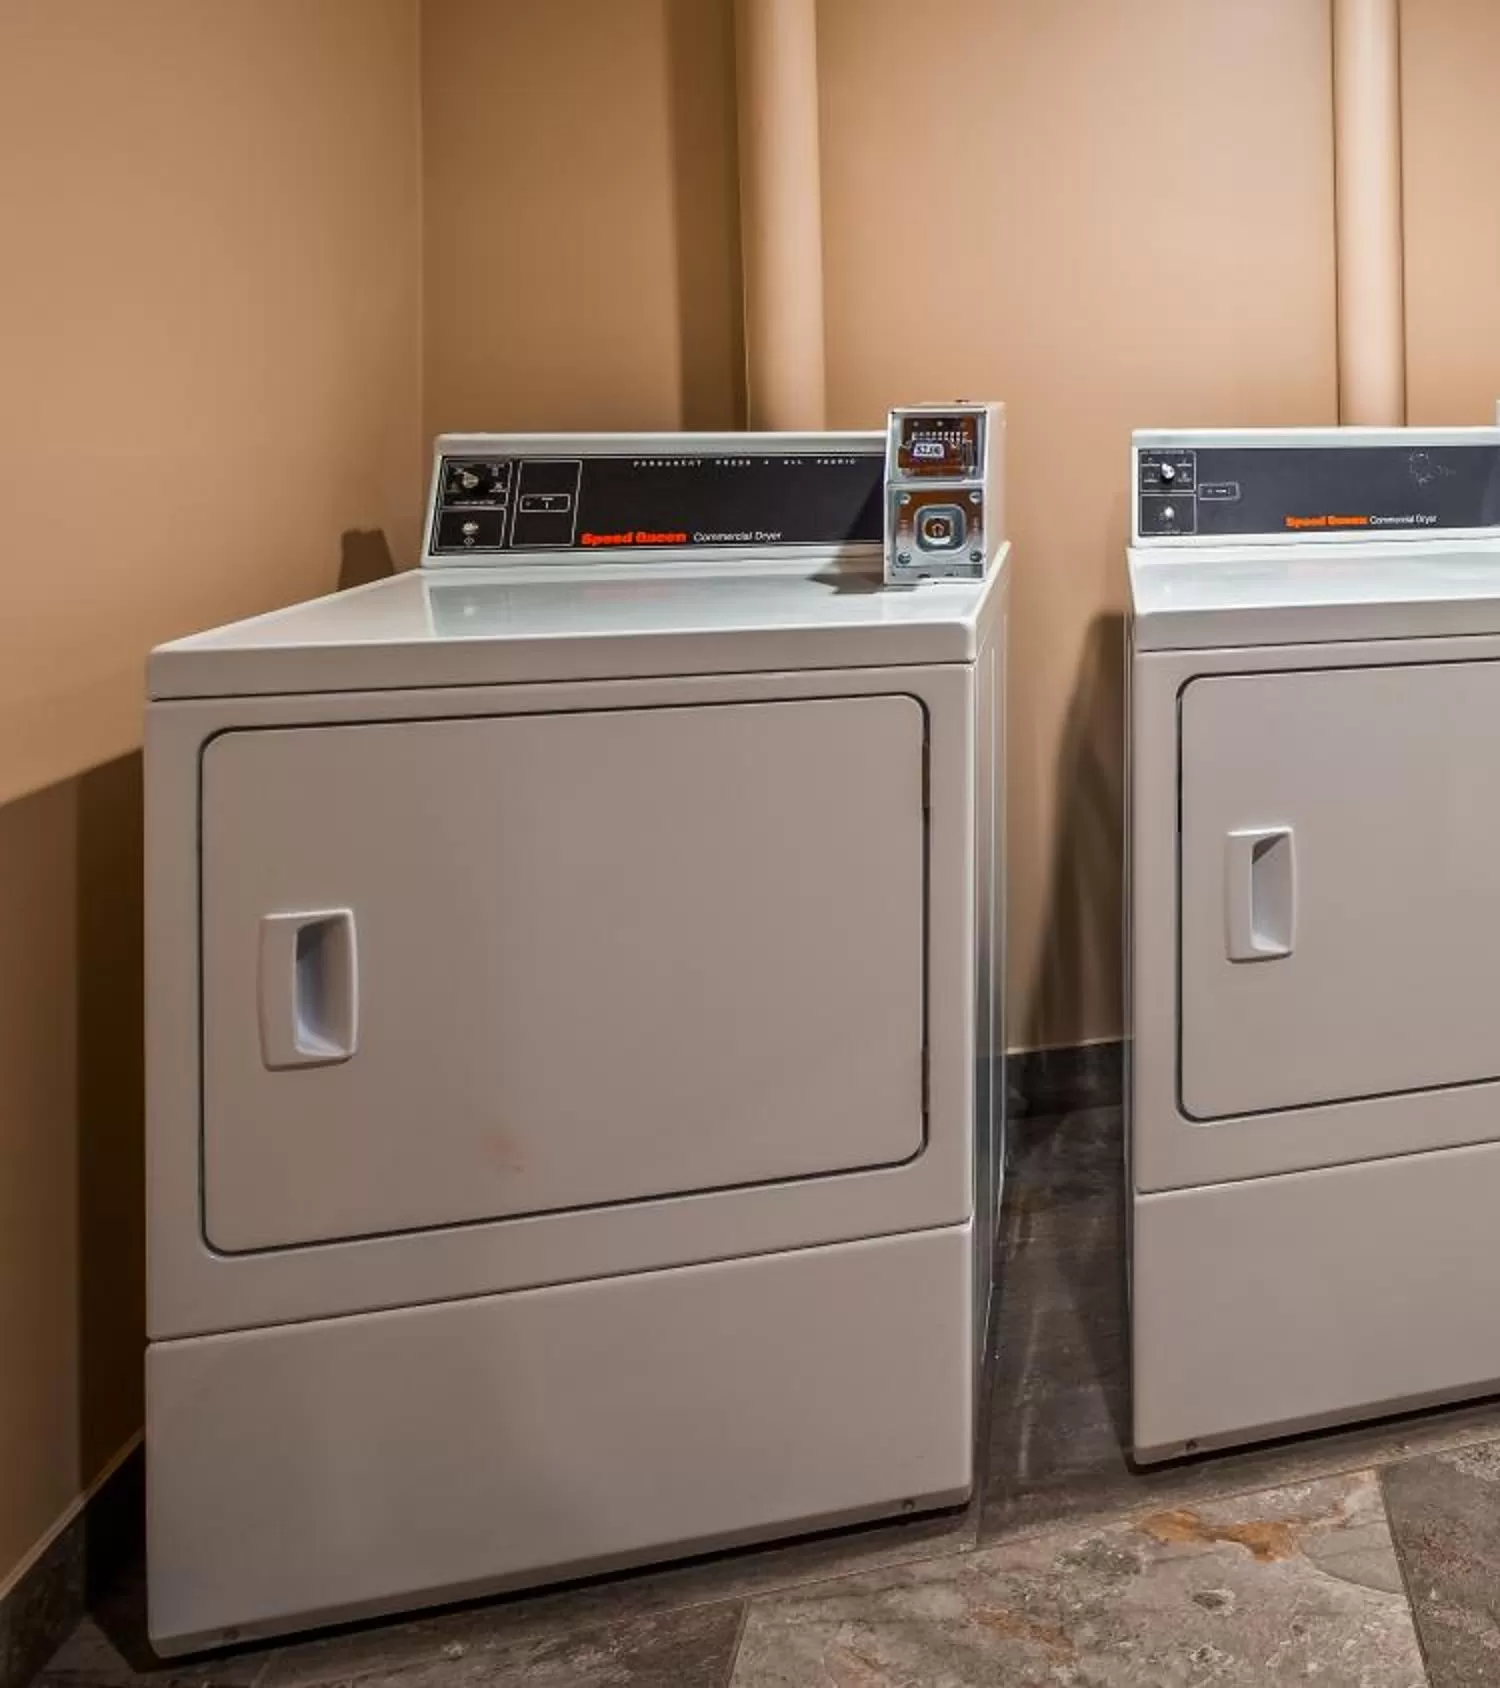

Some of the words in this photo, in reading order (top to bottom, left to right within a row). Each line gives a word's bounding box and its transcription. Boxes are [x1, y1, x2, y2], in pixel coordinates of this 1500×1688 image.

[581, 532, 633, 547] Speed
[635, 531, 687, 544] Queen
[693, 531, 752, 543] Commercial
[754, 530, 781, 544] Dryer
